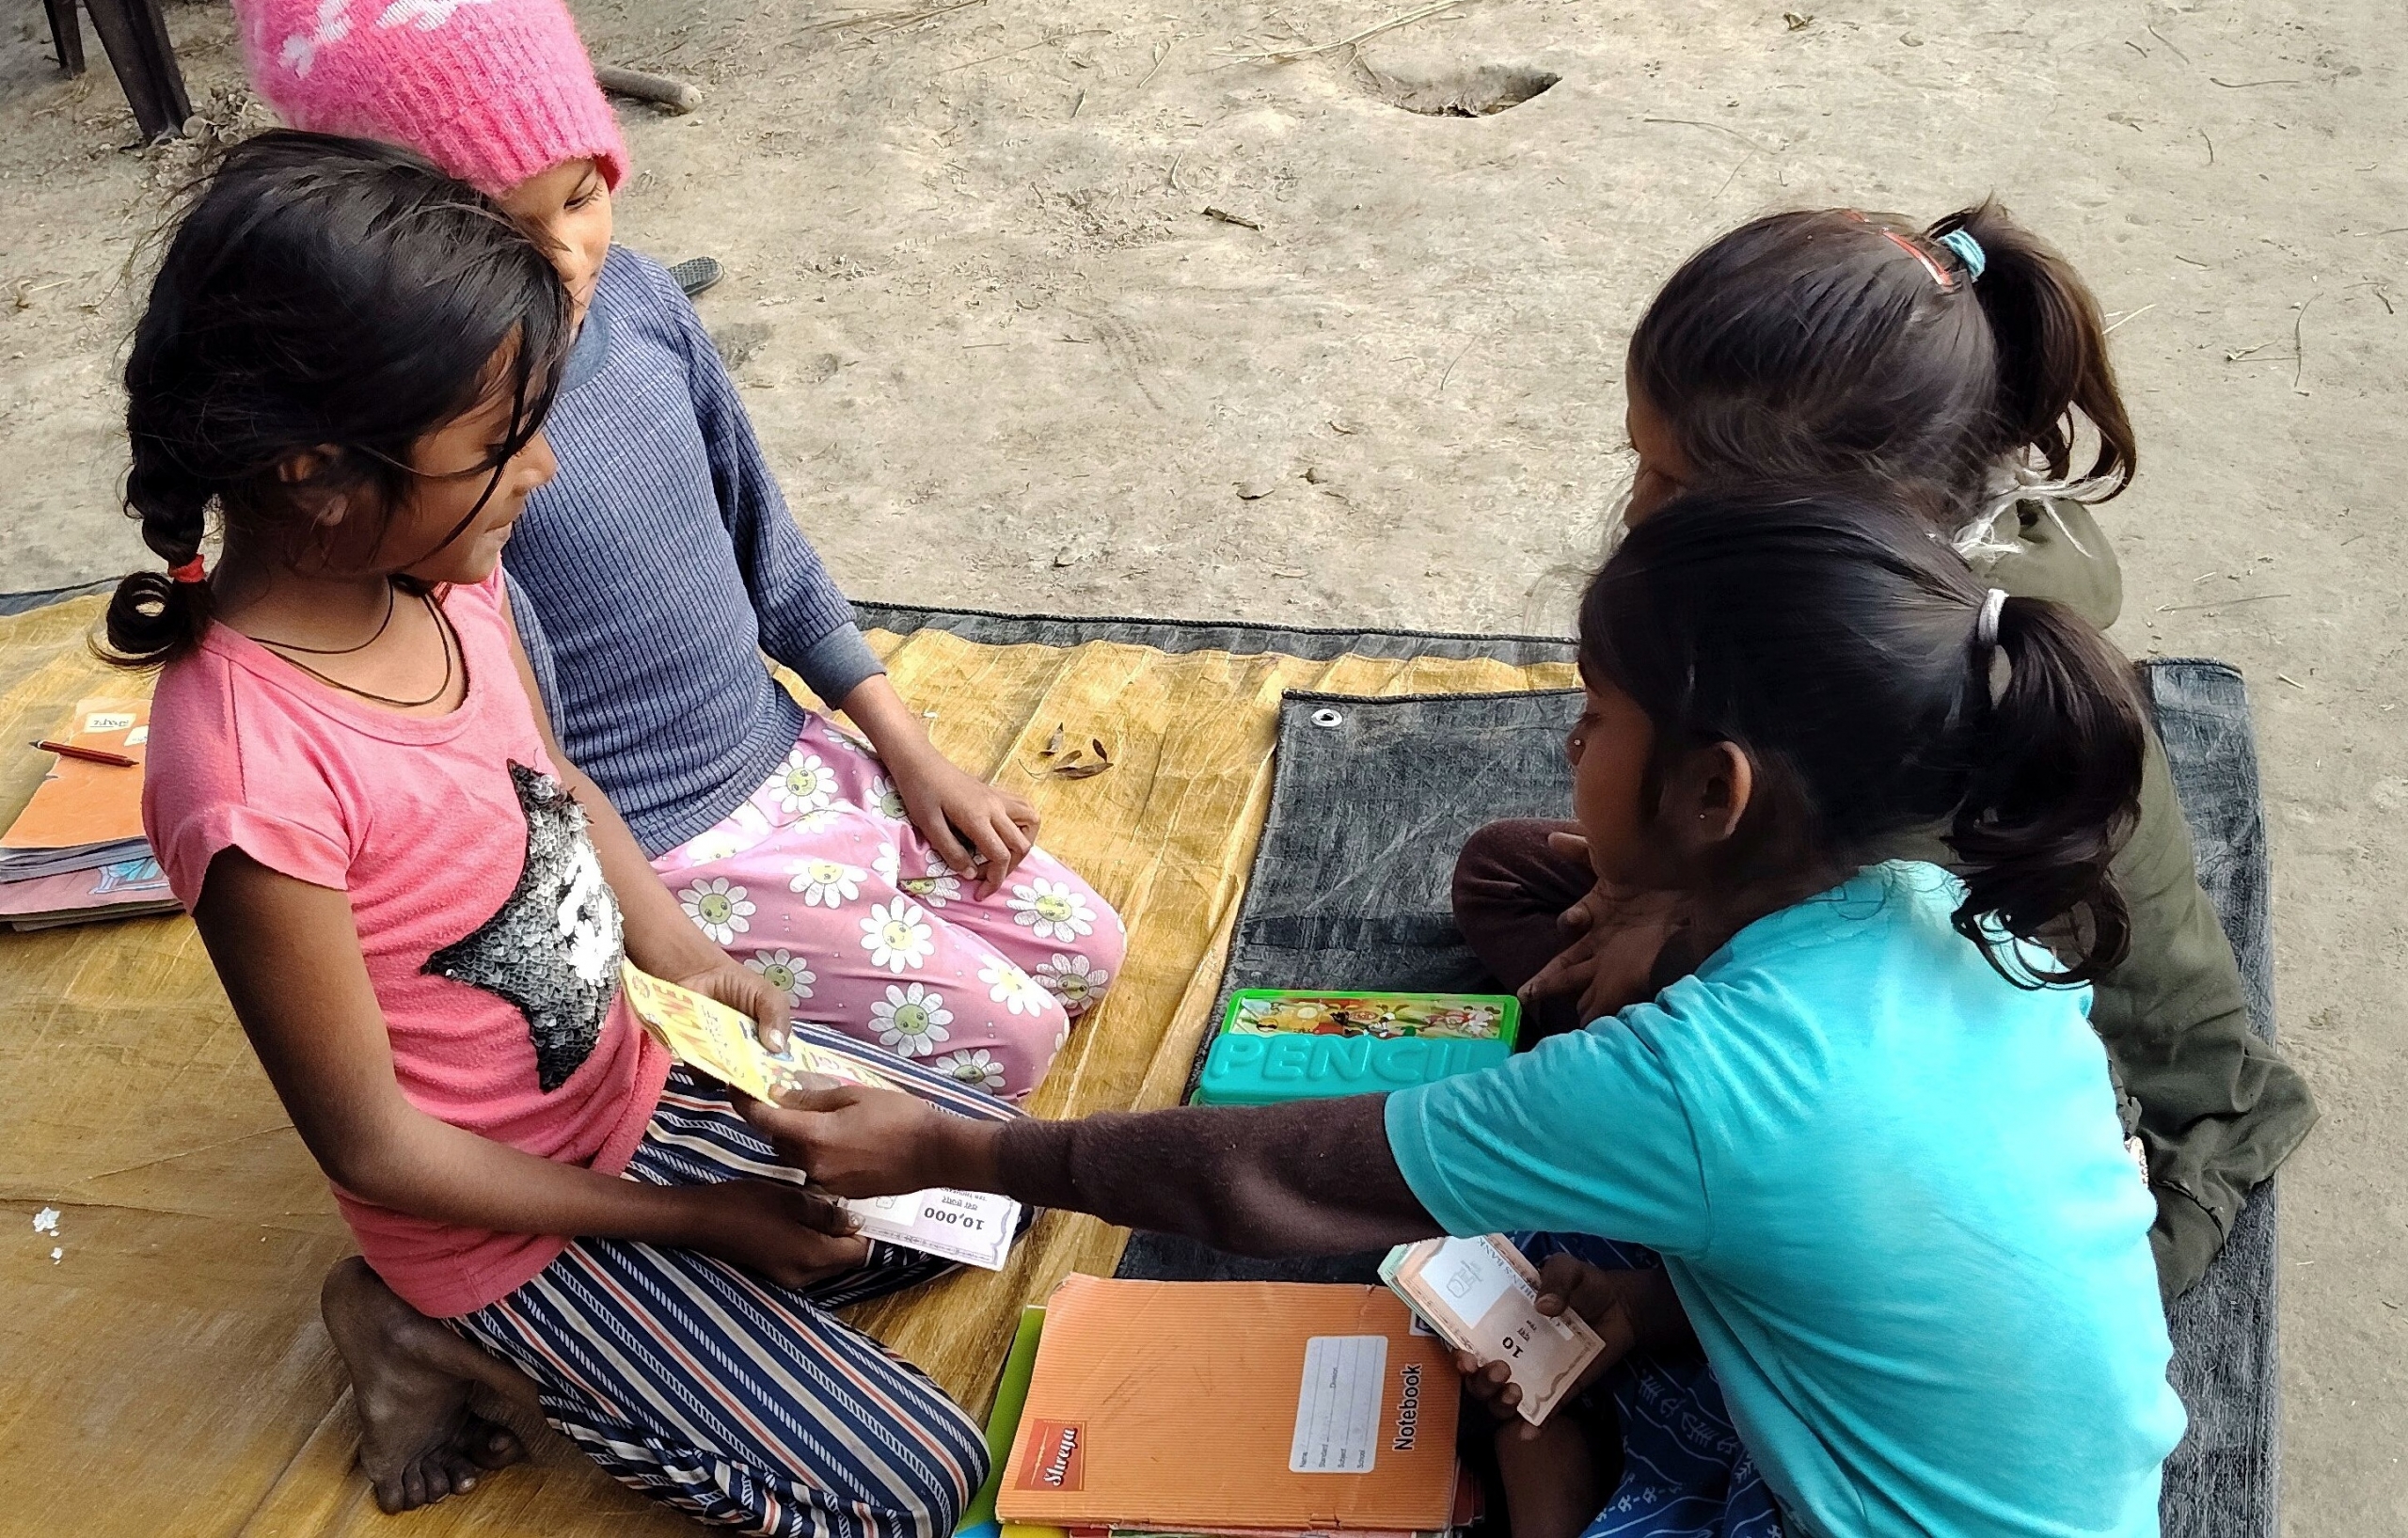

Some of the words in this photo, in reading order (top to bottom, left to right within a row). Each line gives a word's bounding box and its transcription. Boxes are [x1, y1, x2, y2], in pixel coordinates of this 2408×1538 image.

[924, 1207, 985, 1230] 10,000
[1502, 1336, 1524, 1358] 10
[1393, 1364, 1421, 1451] Notebook
[1043, 1427, 1078, 1487] Shreya
[1356, 1450, 1366, 1468] School
